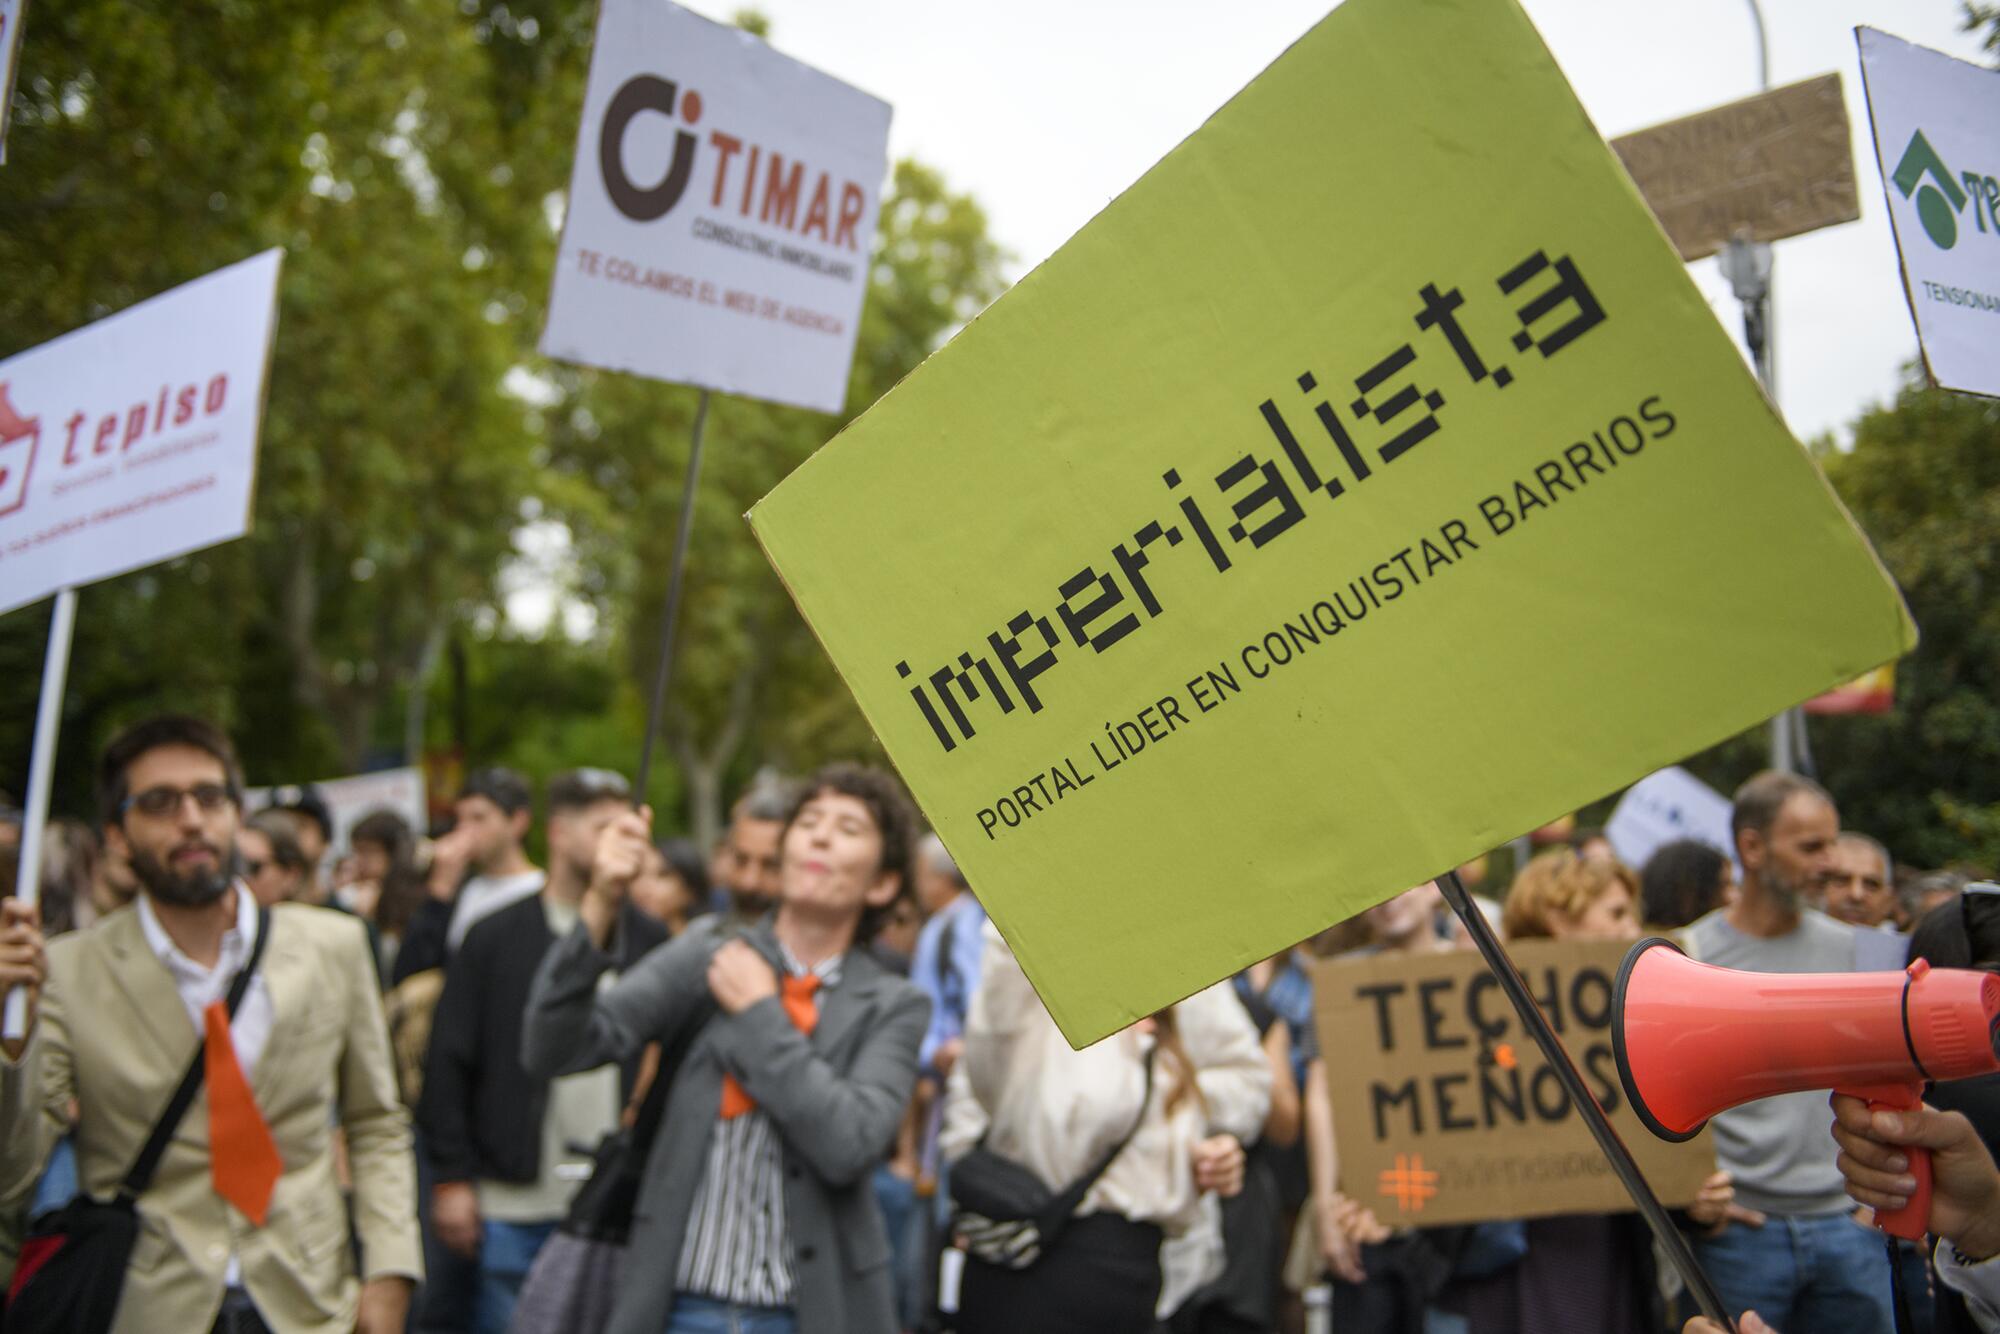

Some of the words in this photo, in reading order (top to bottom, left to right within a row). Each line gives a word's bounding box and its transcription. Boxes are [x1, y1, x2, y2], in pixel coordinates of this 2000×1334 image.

[579, 249, 600, 277] TE
[62, 374, 227, 465] tepiso
[895, 248, 1607, 753] imperialista
[975, 757, 1096, 841] PORTAL
[1089, 695, 1191, 772] LÍDER
[1186, 662, 1241, 714] EN
[1239, 519, 1479, 681] CONQUISTAR
[1477, 394, 1679, 536] BARRIOS
